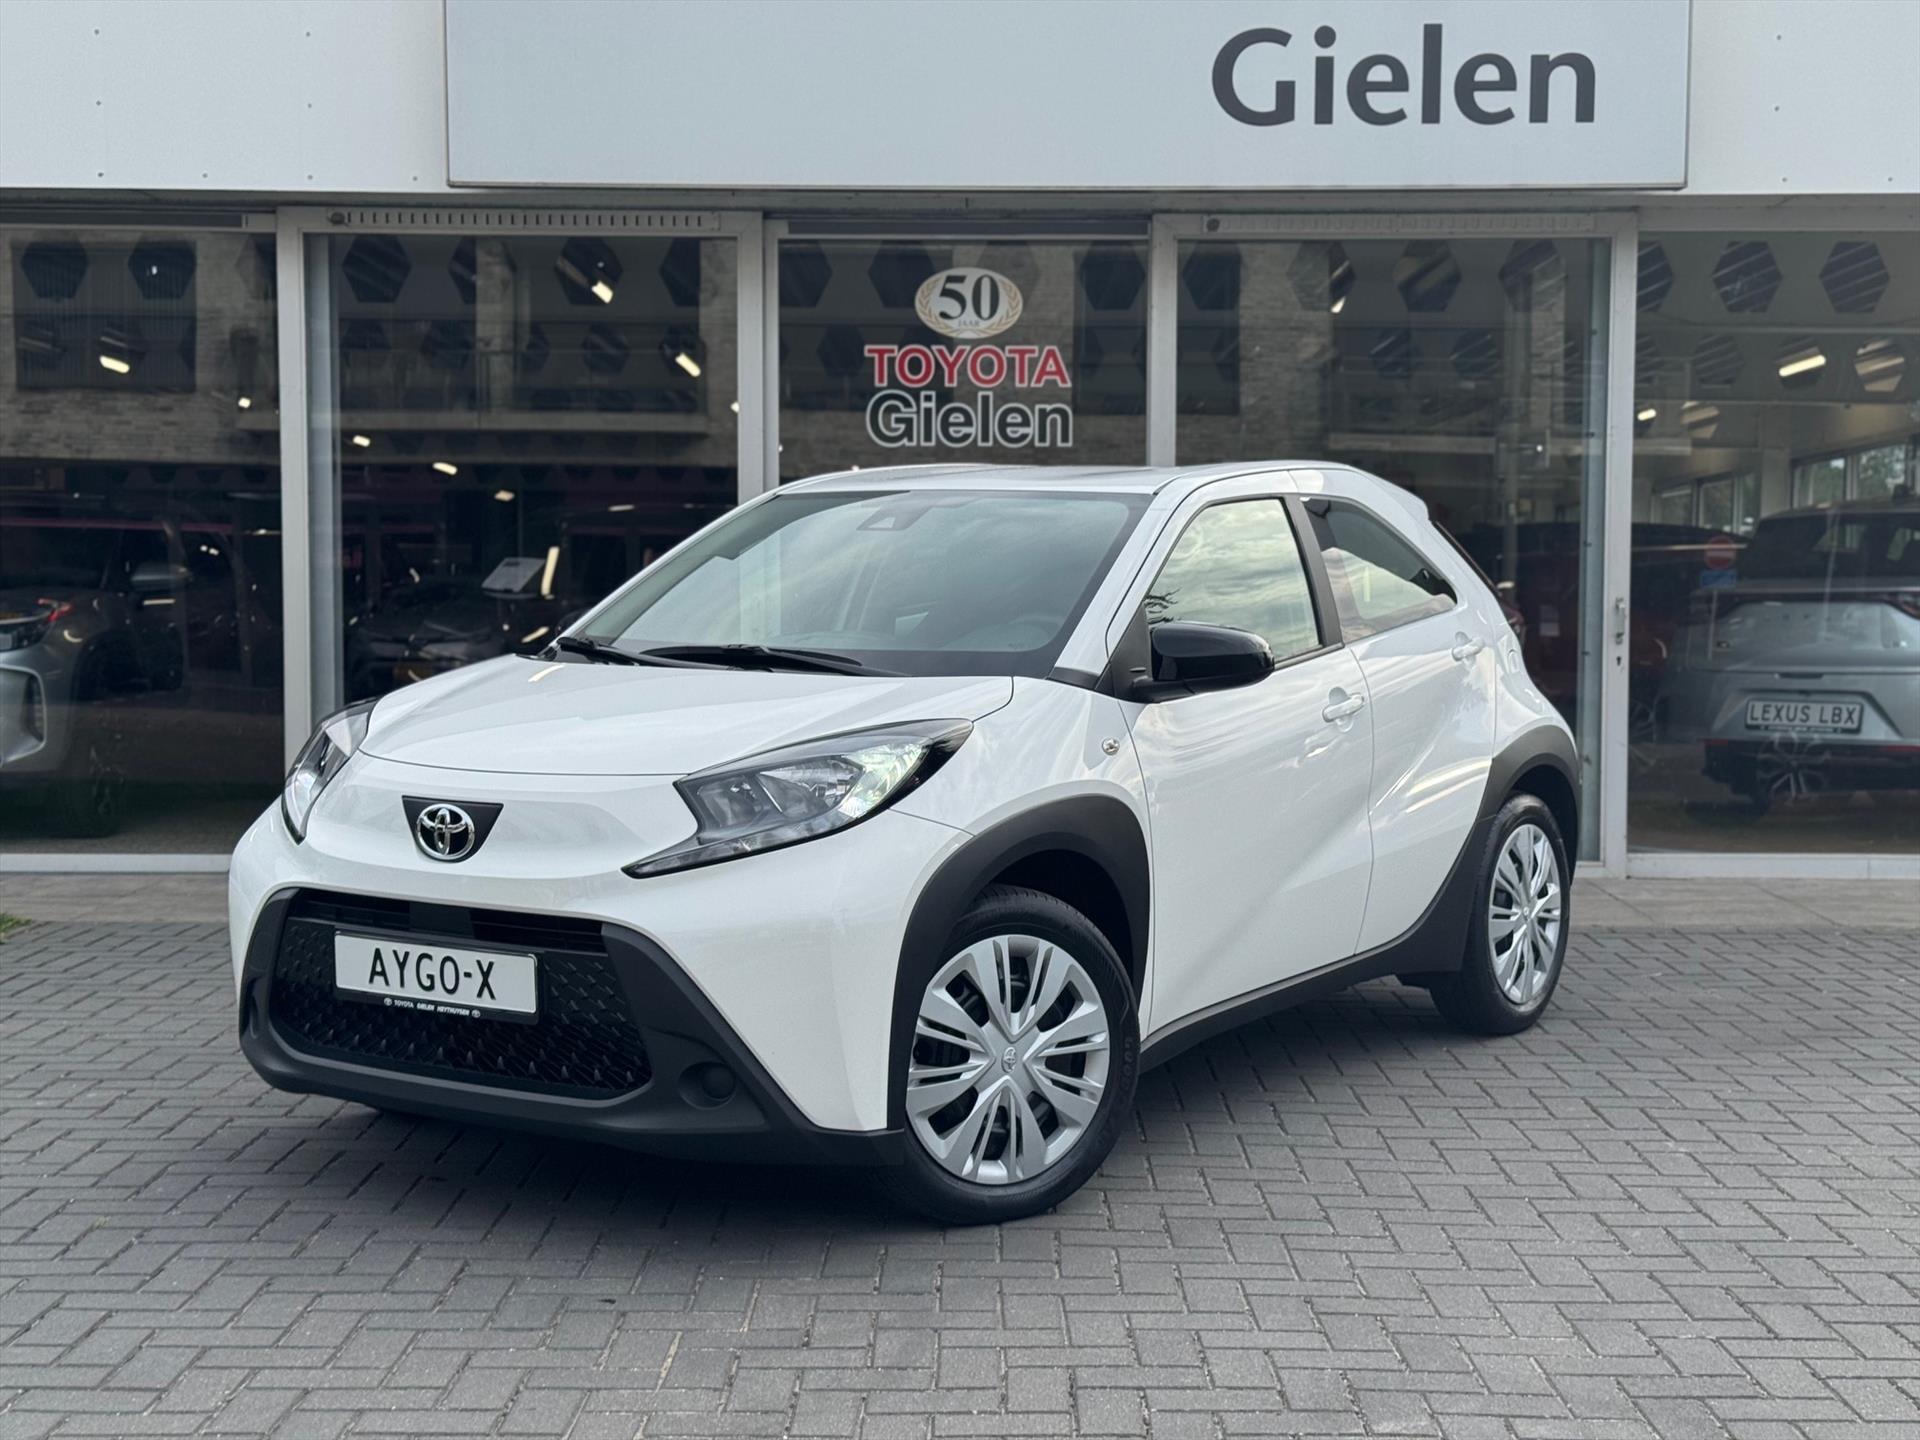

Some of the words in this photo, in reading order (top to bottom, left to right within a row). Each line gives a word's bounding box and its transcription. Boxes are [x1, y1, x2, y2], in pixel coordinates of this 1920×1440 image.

[1212, 23, 1596, 126] Gielen
[938, 274, 1000, 321] 50
[864, 344, 1072, 388] TOYOTA
[866, 389, 1073, 448] Gielen
[1750, 703, 1811, 723] LEXUS
[1819, 706, 1857, 725] LBX
[368, 947, 496, 1000] AYGO-X
[394, 1000, 414, 1008] TOYOTA
